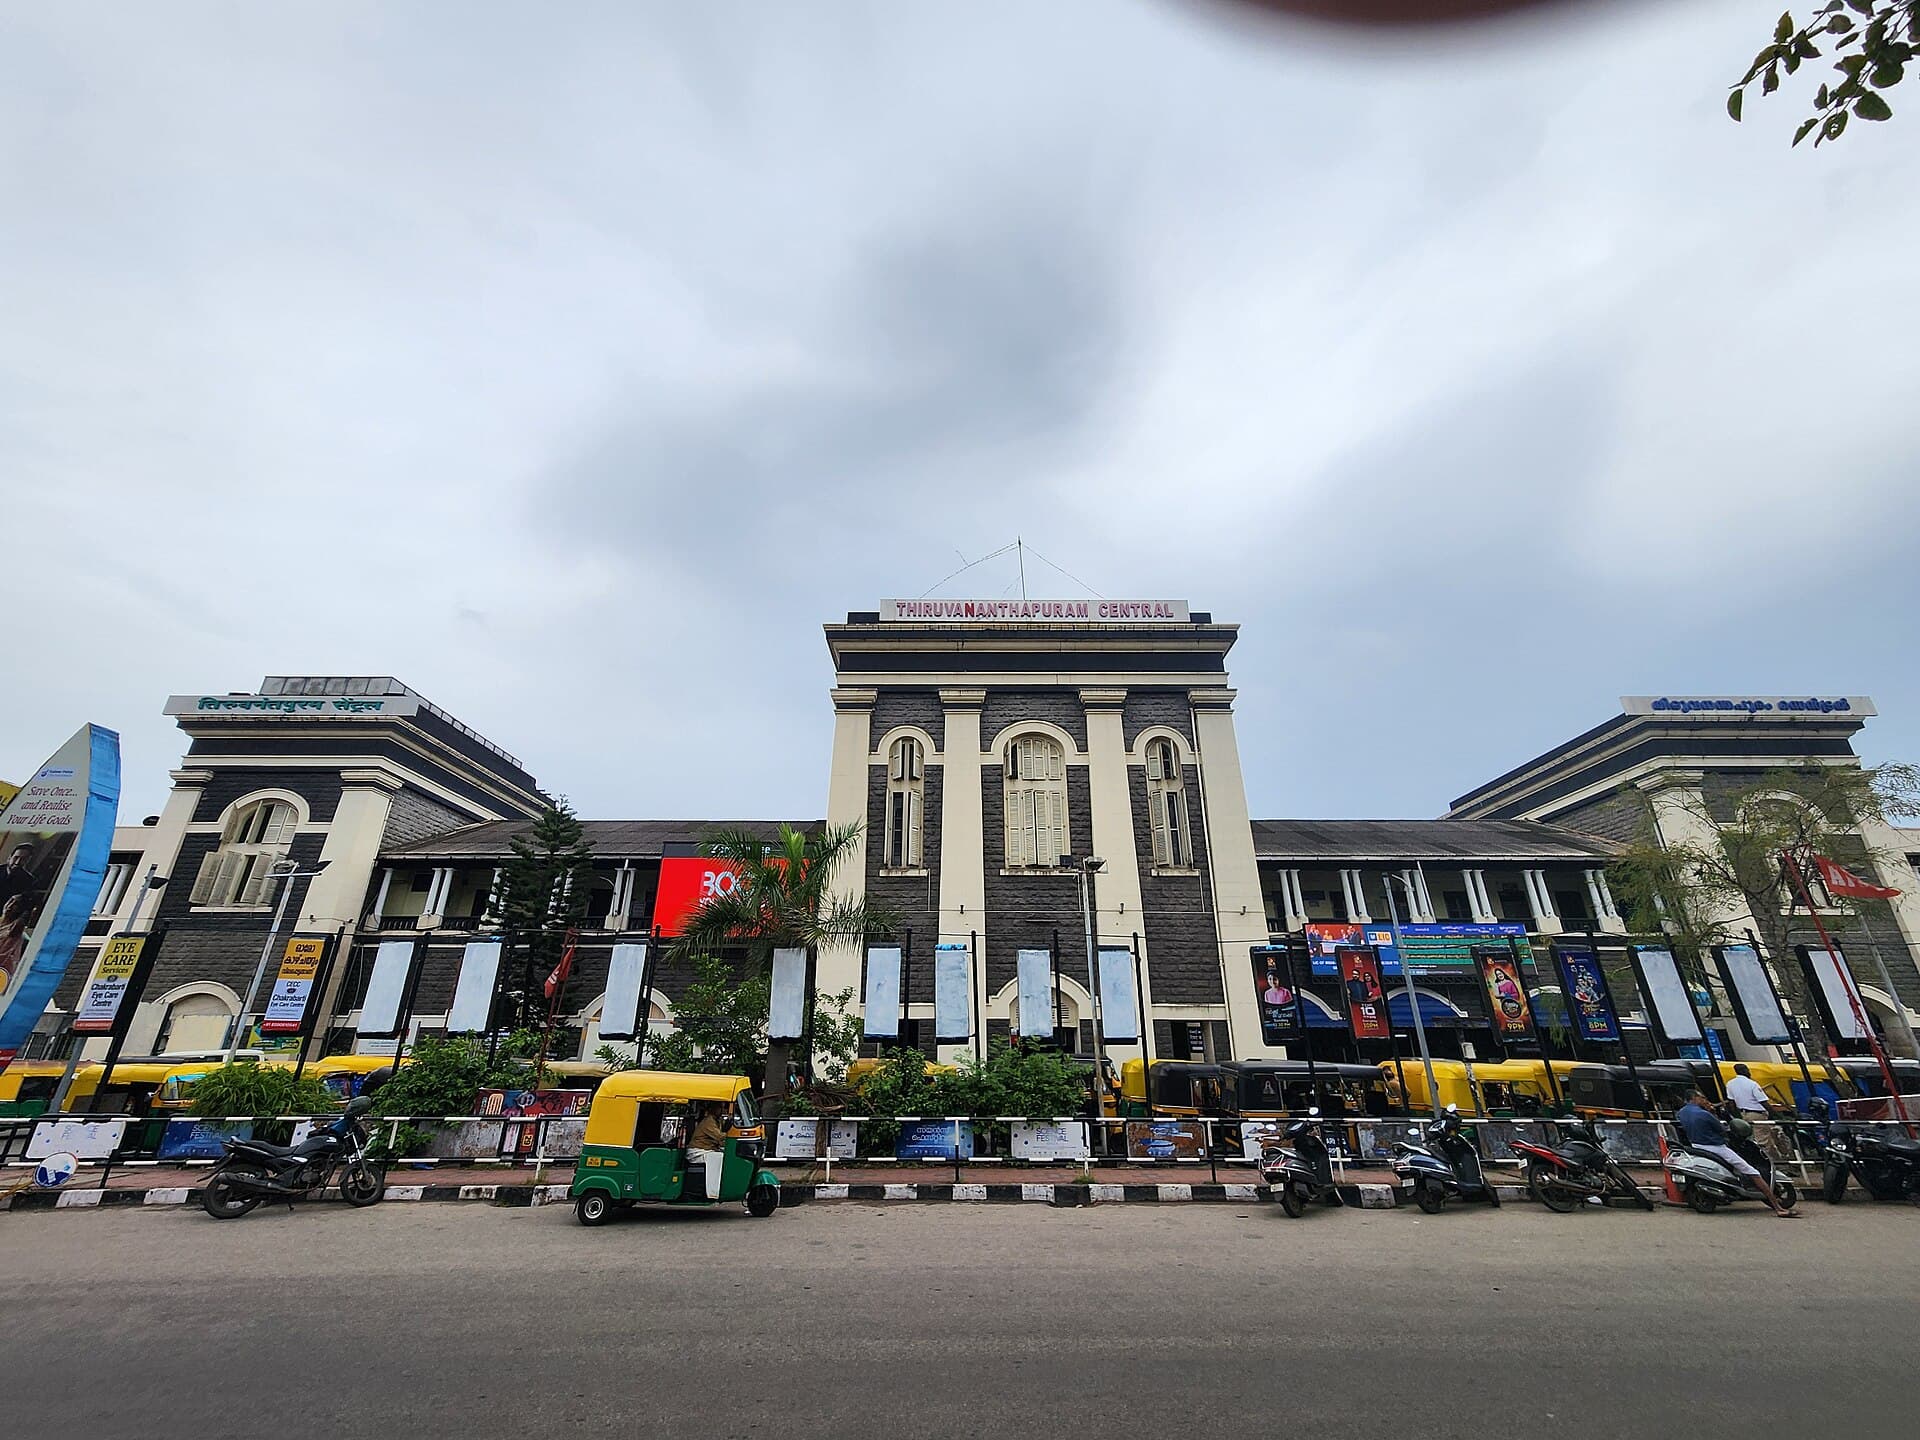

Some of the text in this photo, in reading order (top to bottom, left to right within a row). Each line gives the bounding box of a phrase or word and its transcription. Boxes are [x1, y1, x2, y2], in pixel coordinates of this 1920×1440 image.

[896, 602, 1175, 618] THIRUVANANTHAPURAM CENTRAL
[332, 697, 384, 713] सेंट्रल
[27, 786, 50, 796] Save
[21, 800, 39, 810] and
[39, 800, 72, 810] Realise
[7, 814, 72, 827] Your Life Goals
[112, 942, 136, 953] EYE
[103, 954, 136, 966] CARE
[91, 991, 119, 999] Eye Care
